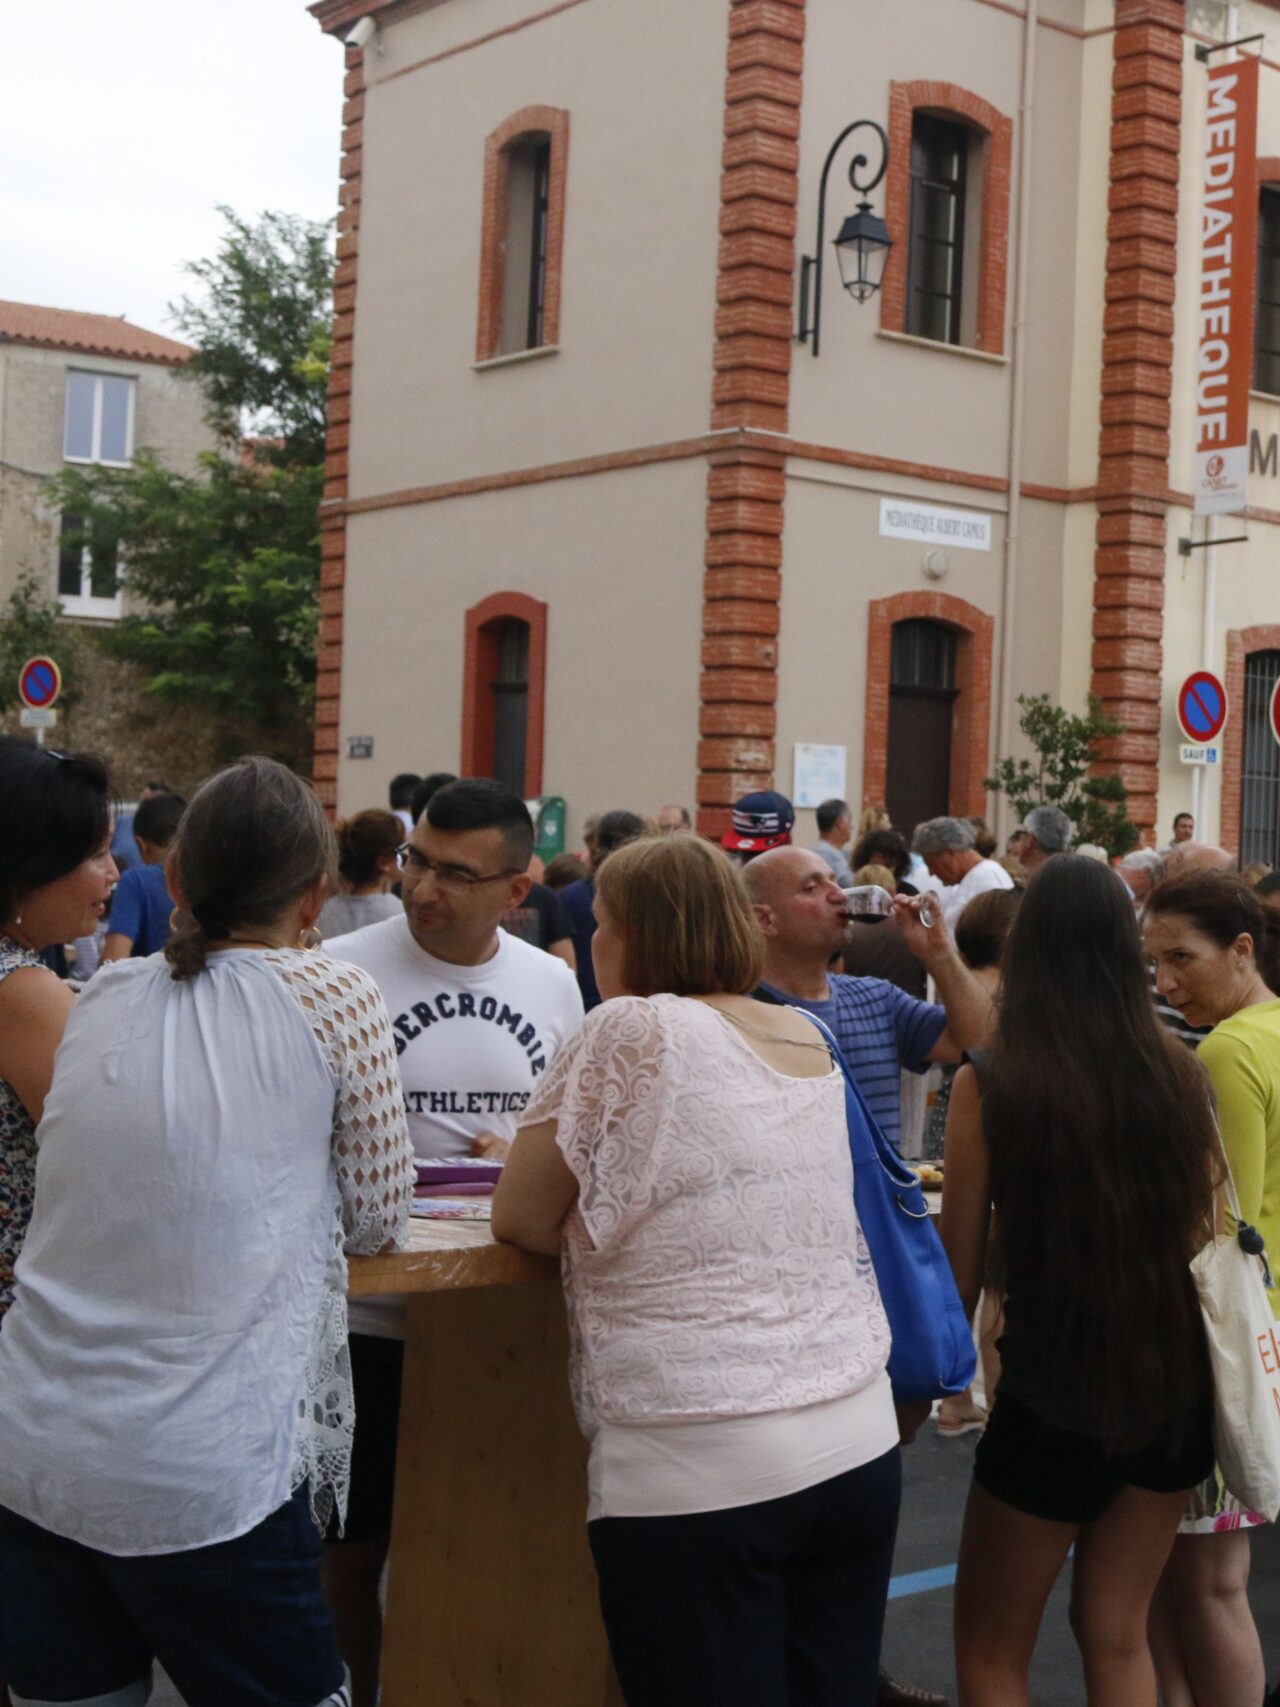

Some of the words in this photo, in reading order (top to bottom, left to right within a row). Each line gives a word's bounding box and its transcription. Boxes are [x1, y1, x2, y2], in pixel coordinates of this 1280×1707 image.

[1196, 74, 1238, 444] MEDIATHEQUE
[962, 520, 986, 540] CAMUS
[1183, 748, 1205, 759] SAUF
